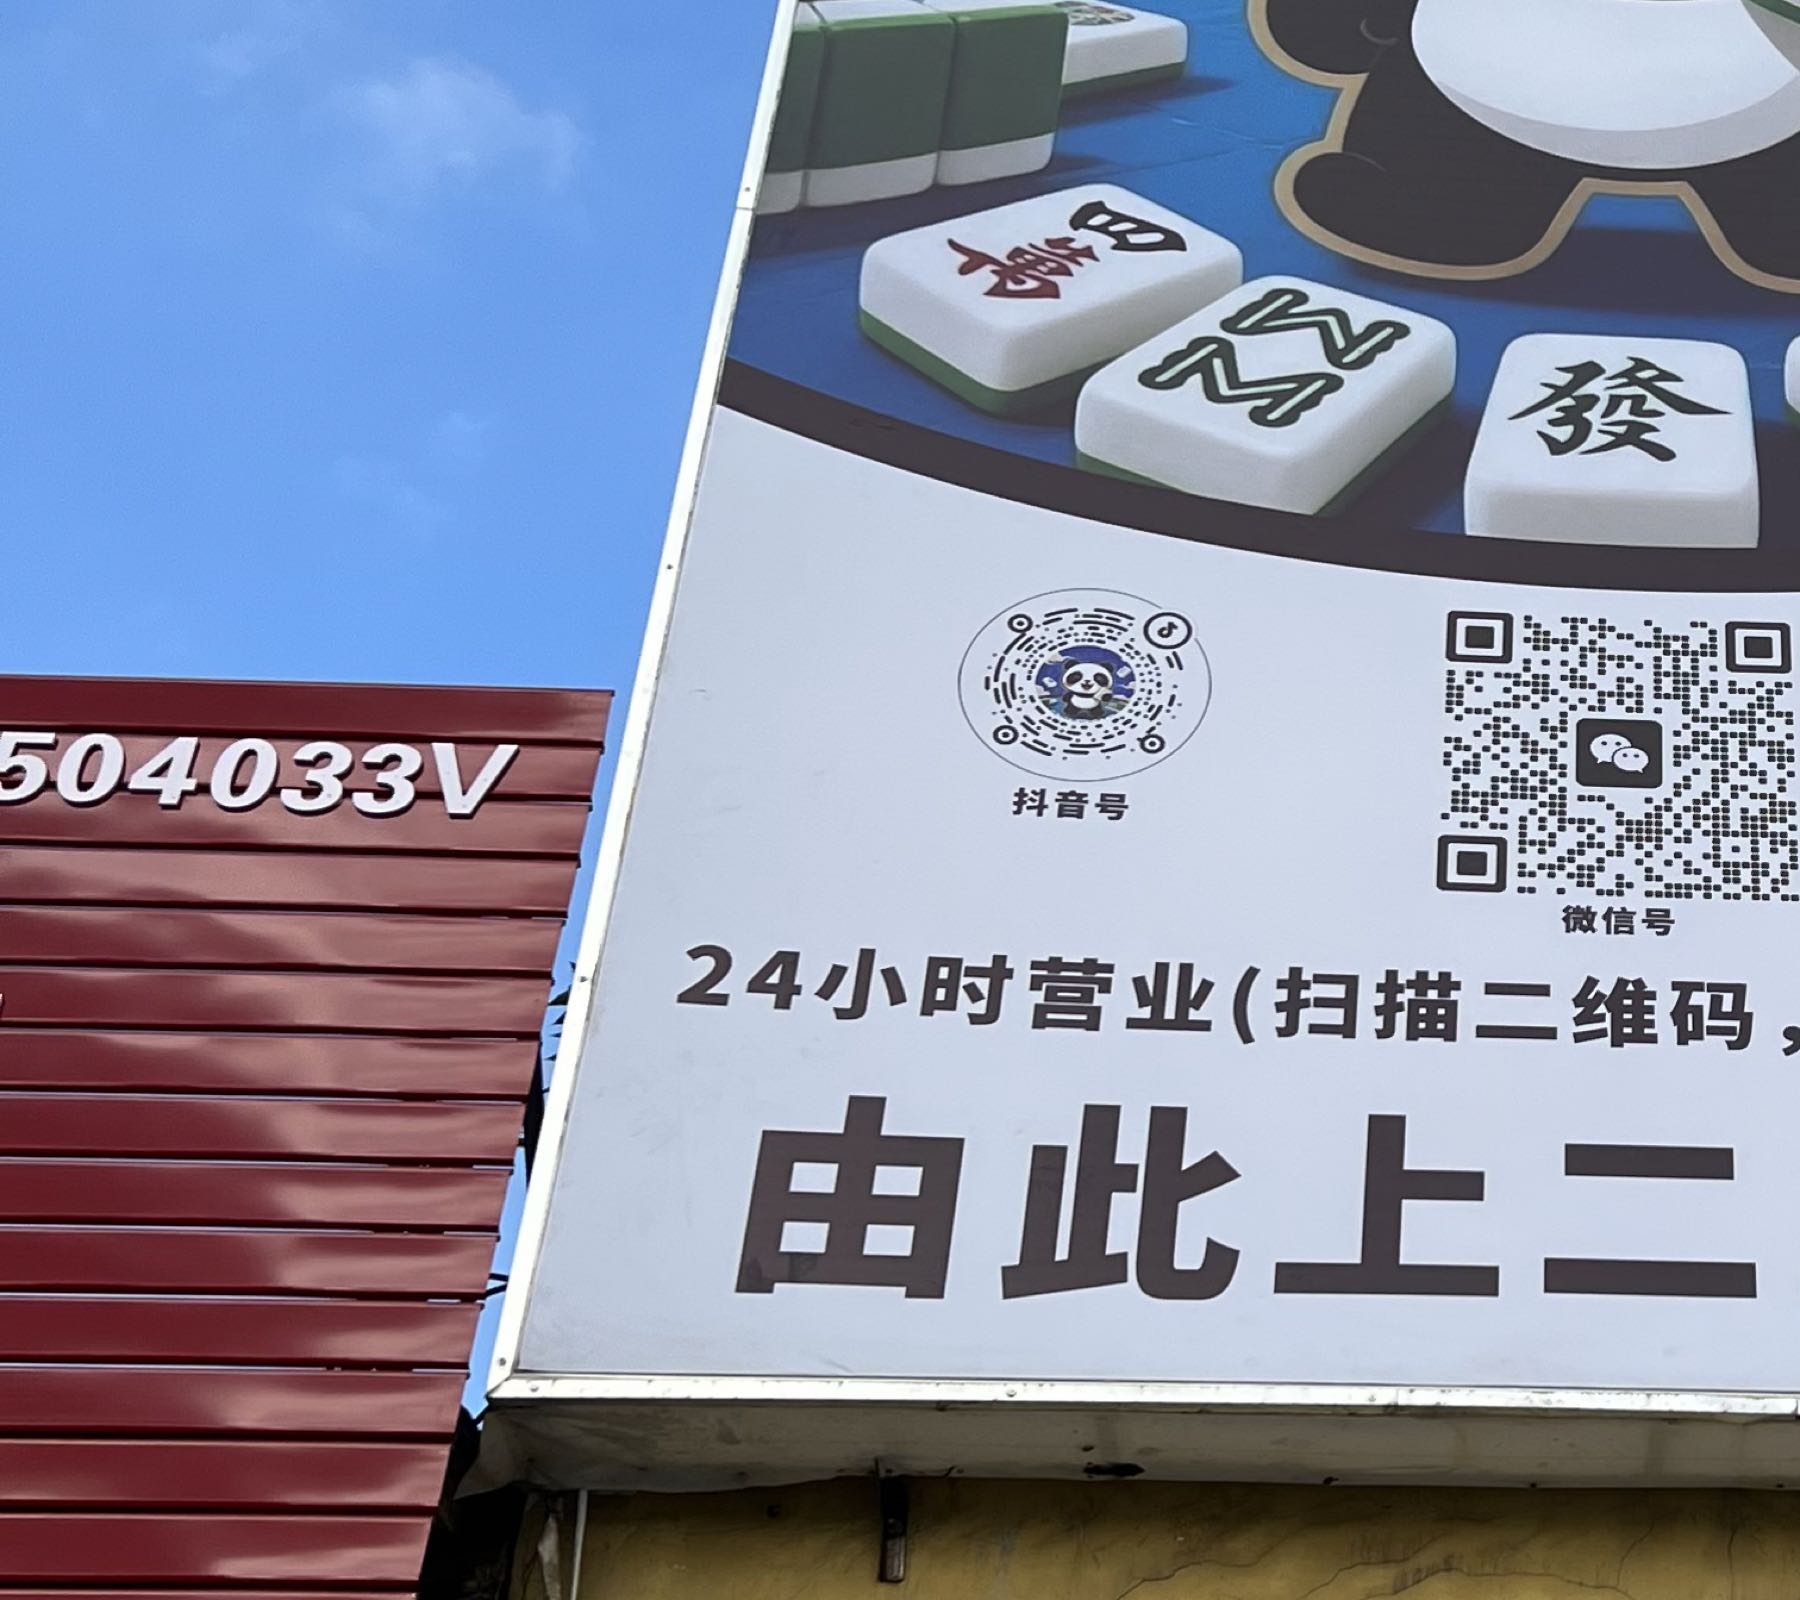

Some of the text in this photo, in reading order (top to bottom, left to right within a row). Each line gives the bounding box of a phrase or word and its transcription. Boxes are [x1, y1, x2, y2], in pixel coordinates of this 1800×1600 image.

[1508, 355, 1730, 463] 發
[1011, 786, 1129, 822] 抖音号
[1561, 904, 1677, 938] 微信号
